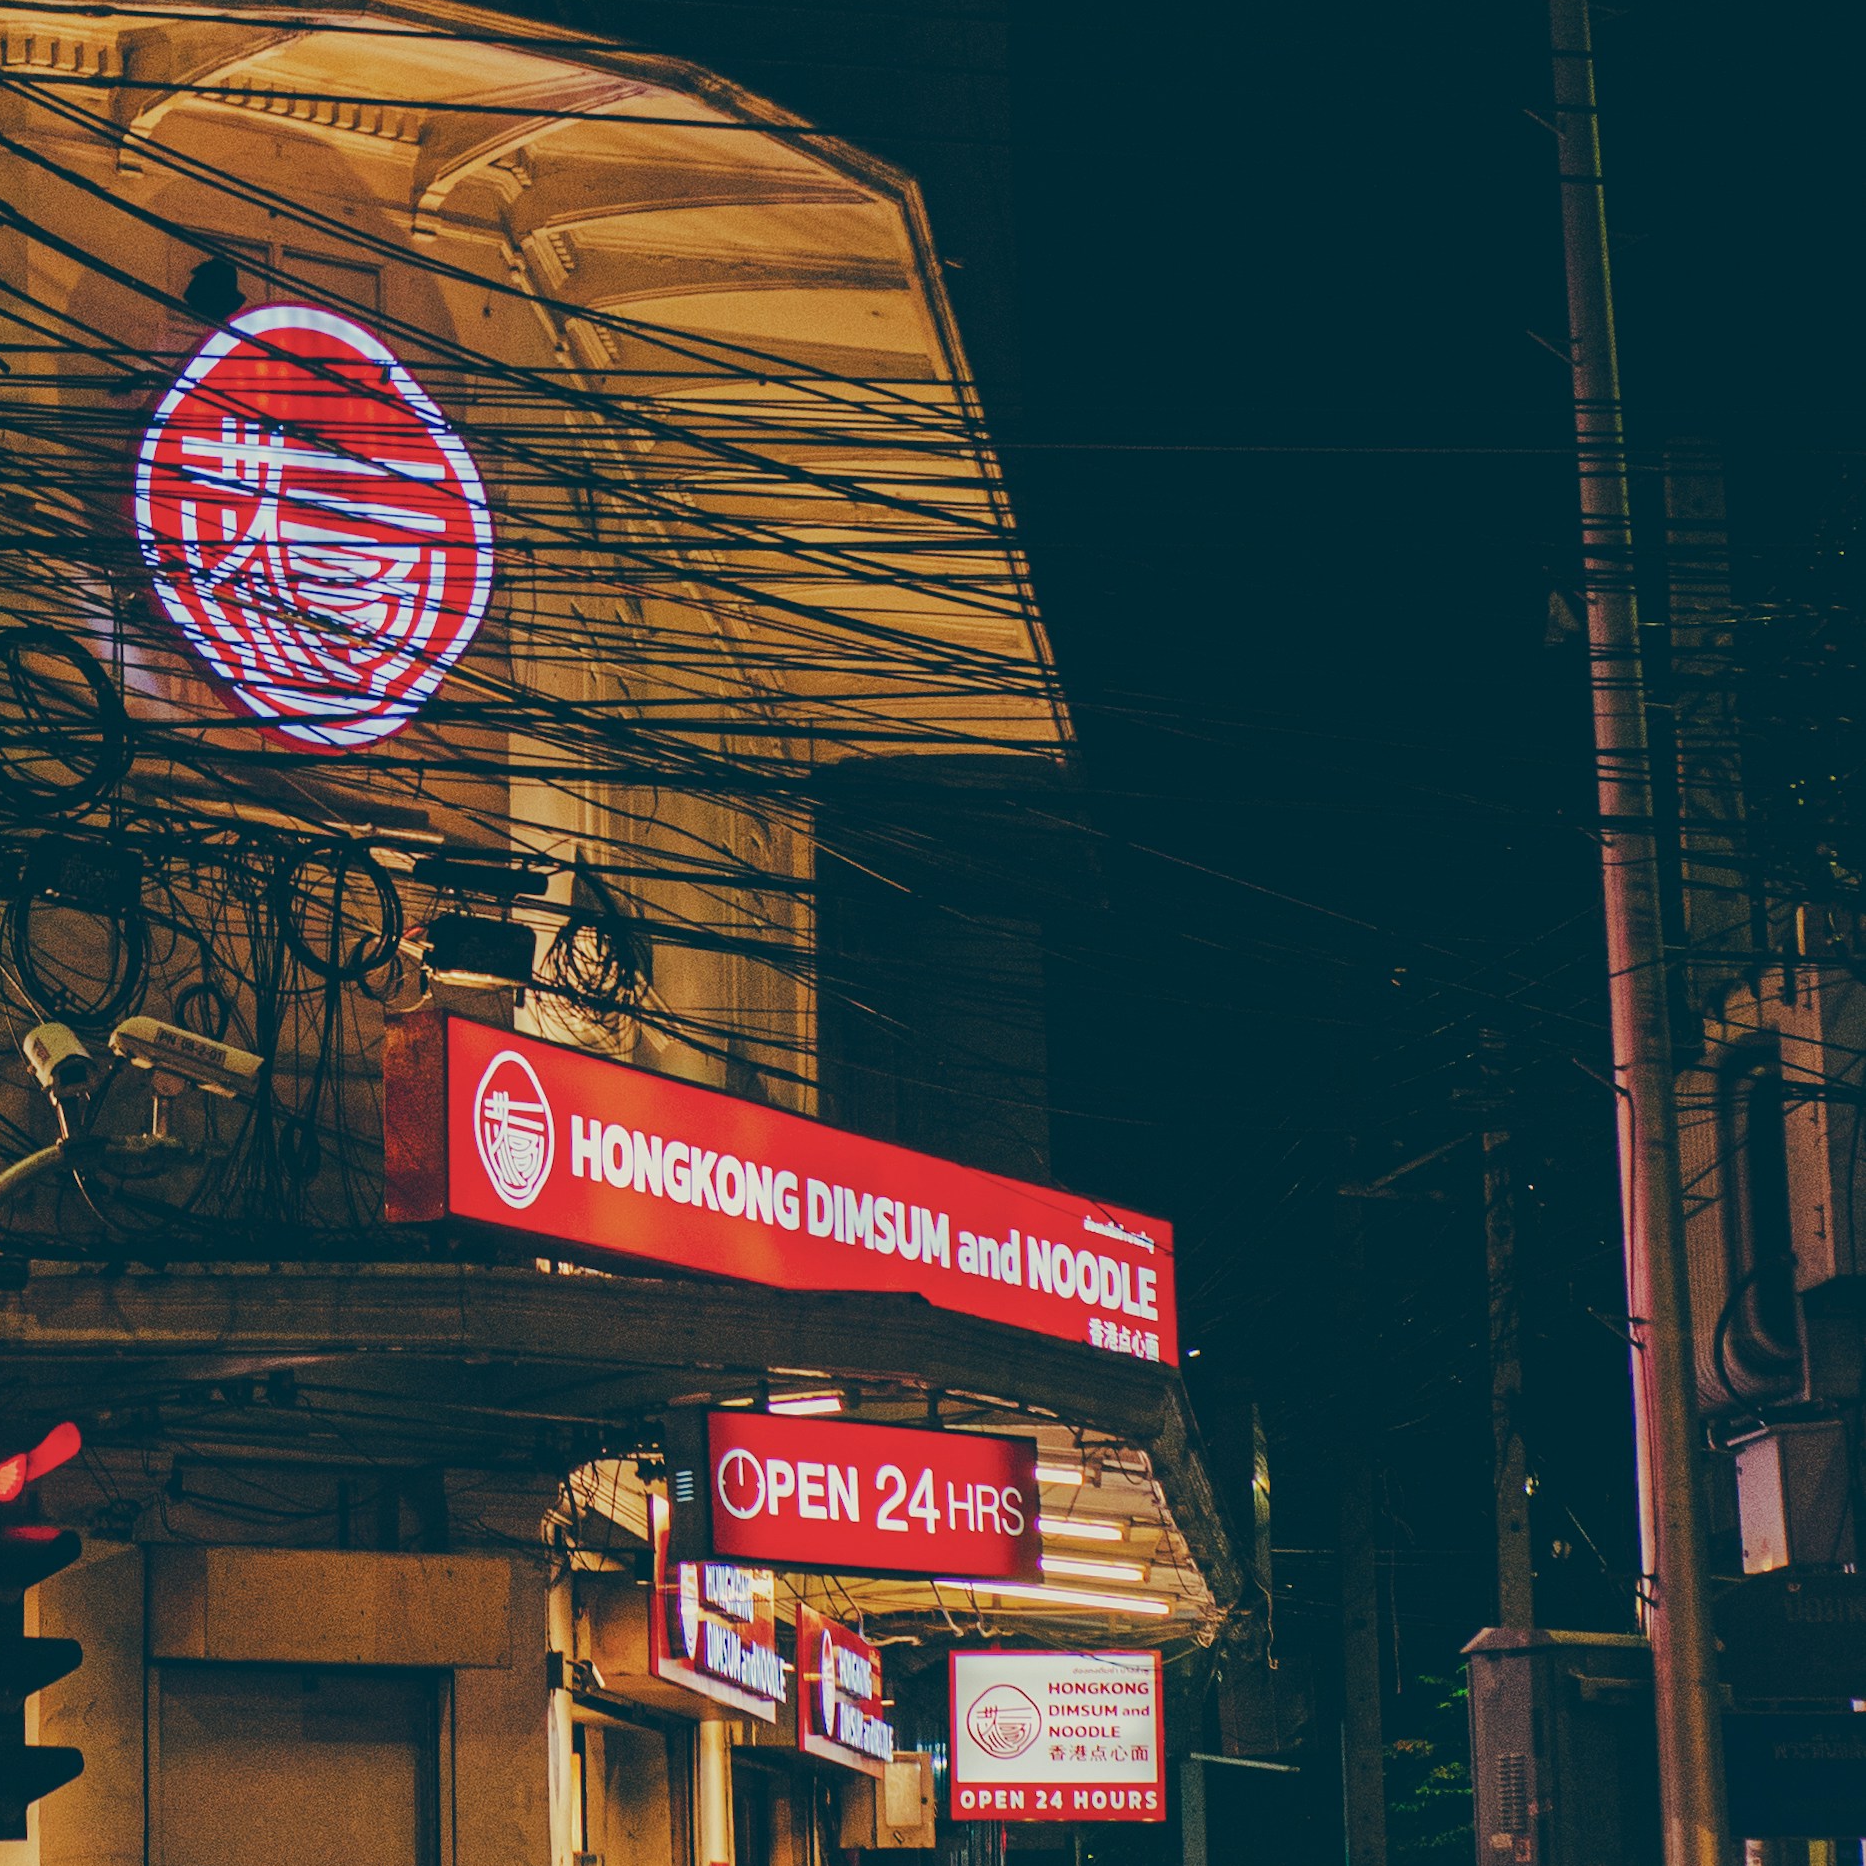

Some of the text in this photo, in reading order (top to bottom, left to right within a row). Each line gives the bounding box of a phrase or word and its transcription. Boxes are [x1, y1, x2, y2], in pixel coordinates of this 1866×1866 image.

[571, 1115, 801, 1231] HONGKONG
[806, 1178, 950, 1269] DIMSUM
[958, 1229, 1022, 1286] and
[1028, 1236, 1159, 1321] NOODLE
[717, 1448, 1025, 1536] OPEN 24 HRS
[1048, 1682, 1149, 1695] HONGKONG
[1048, 1705, 1150, 1716] DIMSUM and
[1048, 1725, 1121, 1738] NOODLE
[1049, 1745, 1149, 1762] 香港点心面
[959, 1789, 1158, 1810] OPEN 24 HOURS
